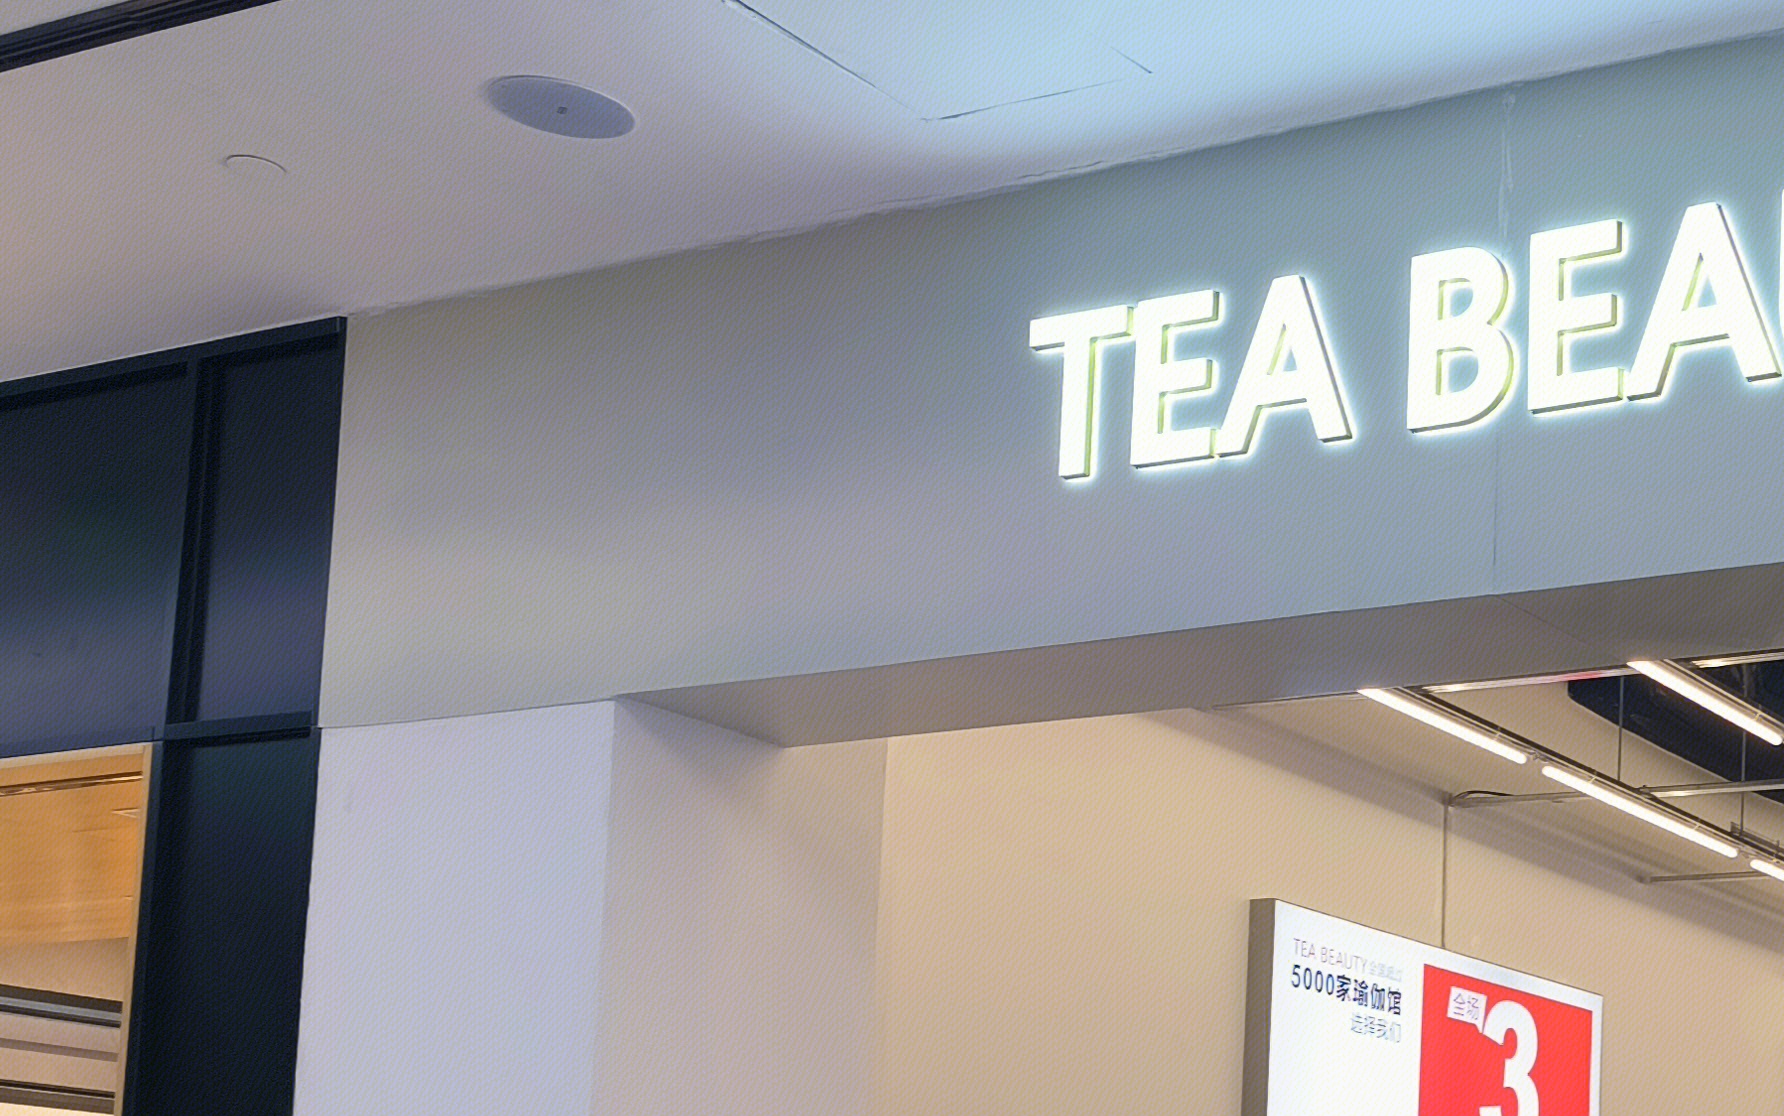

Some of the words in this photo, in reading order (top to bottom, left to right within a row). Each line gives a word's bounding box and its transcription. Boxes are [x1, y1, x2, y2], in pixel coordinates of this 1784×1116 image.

[1028, 274, 1355, 481] TEA
[1293, 937, 1317, 960] TEA
[1321, 946, 1368, 974] BEAUTY
[1291, 964, 1402, 1015] 5000家瑜伽馆
[1453, 992, 1481, 1021] 全场
[1350, 1013, 1402, 1043] 选择我们
